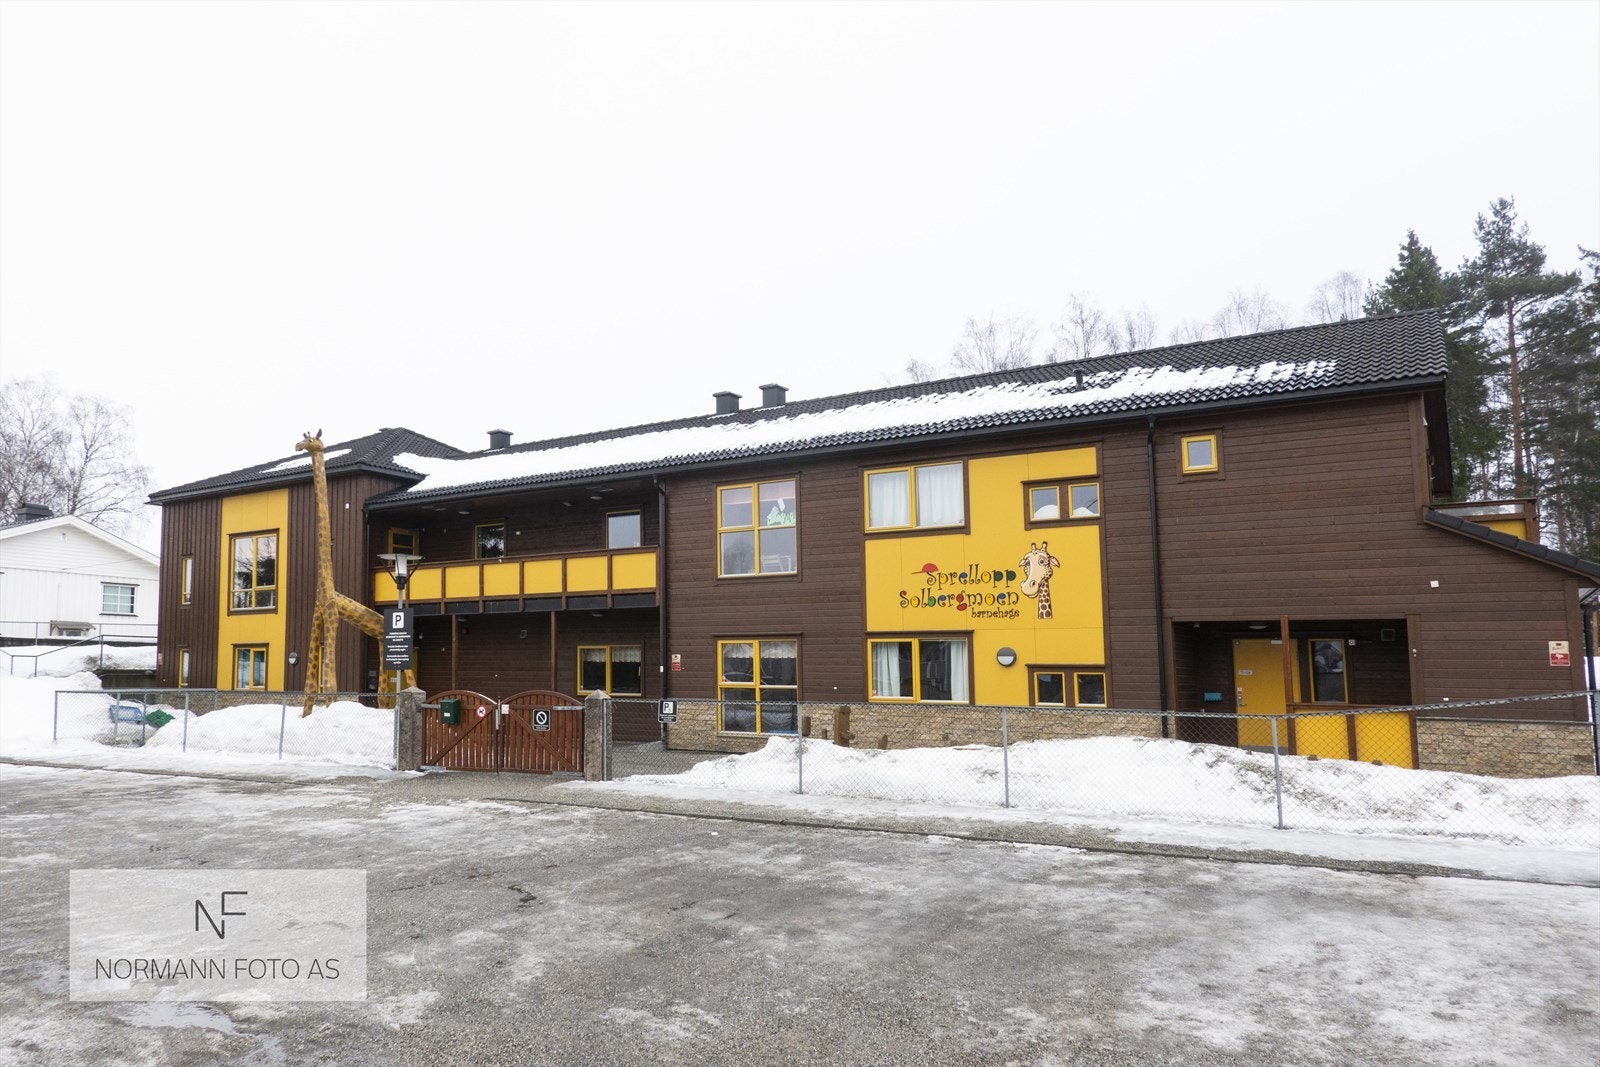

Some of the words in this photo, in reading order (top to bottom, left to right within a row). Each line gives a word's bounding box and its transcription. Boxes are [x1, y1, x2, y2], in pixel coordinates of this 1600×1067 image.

[926, 564, 1017, 590] Sprellopp
[899, 588, 1019, 611] Solbergmoen
[971, 608, 1020, 619] barnehage
[395, 615, 401, 626] P
[664, 703, 670, 711] P
